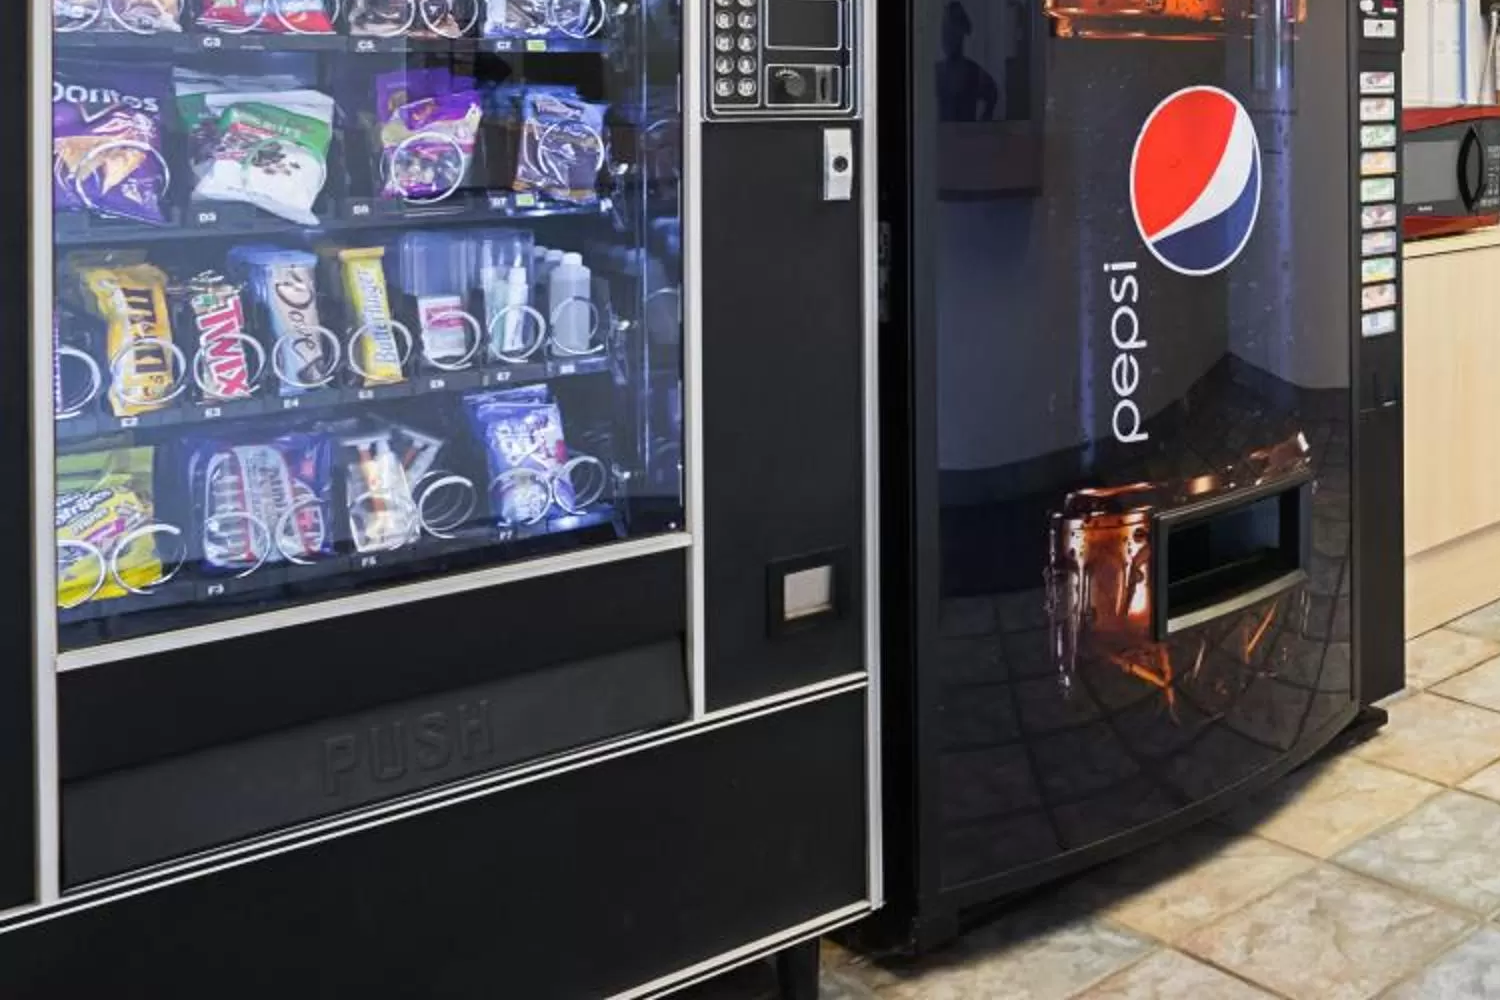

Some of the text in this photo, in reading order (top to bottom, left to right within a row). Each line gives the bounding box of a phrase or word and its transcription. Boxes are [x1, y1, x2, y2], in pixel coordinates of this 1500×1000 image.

[198, 297, 251, 397] TWIX
[1103, 260, 1150, 444] pepsi
[322, 699, 496, 797] PUSH
